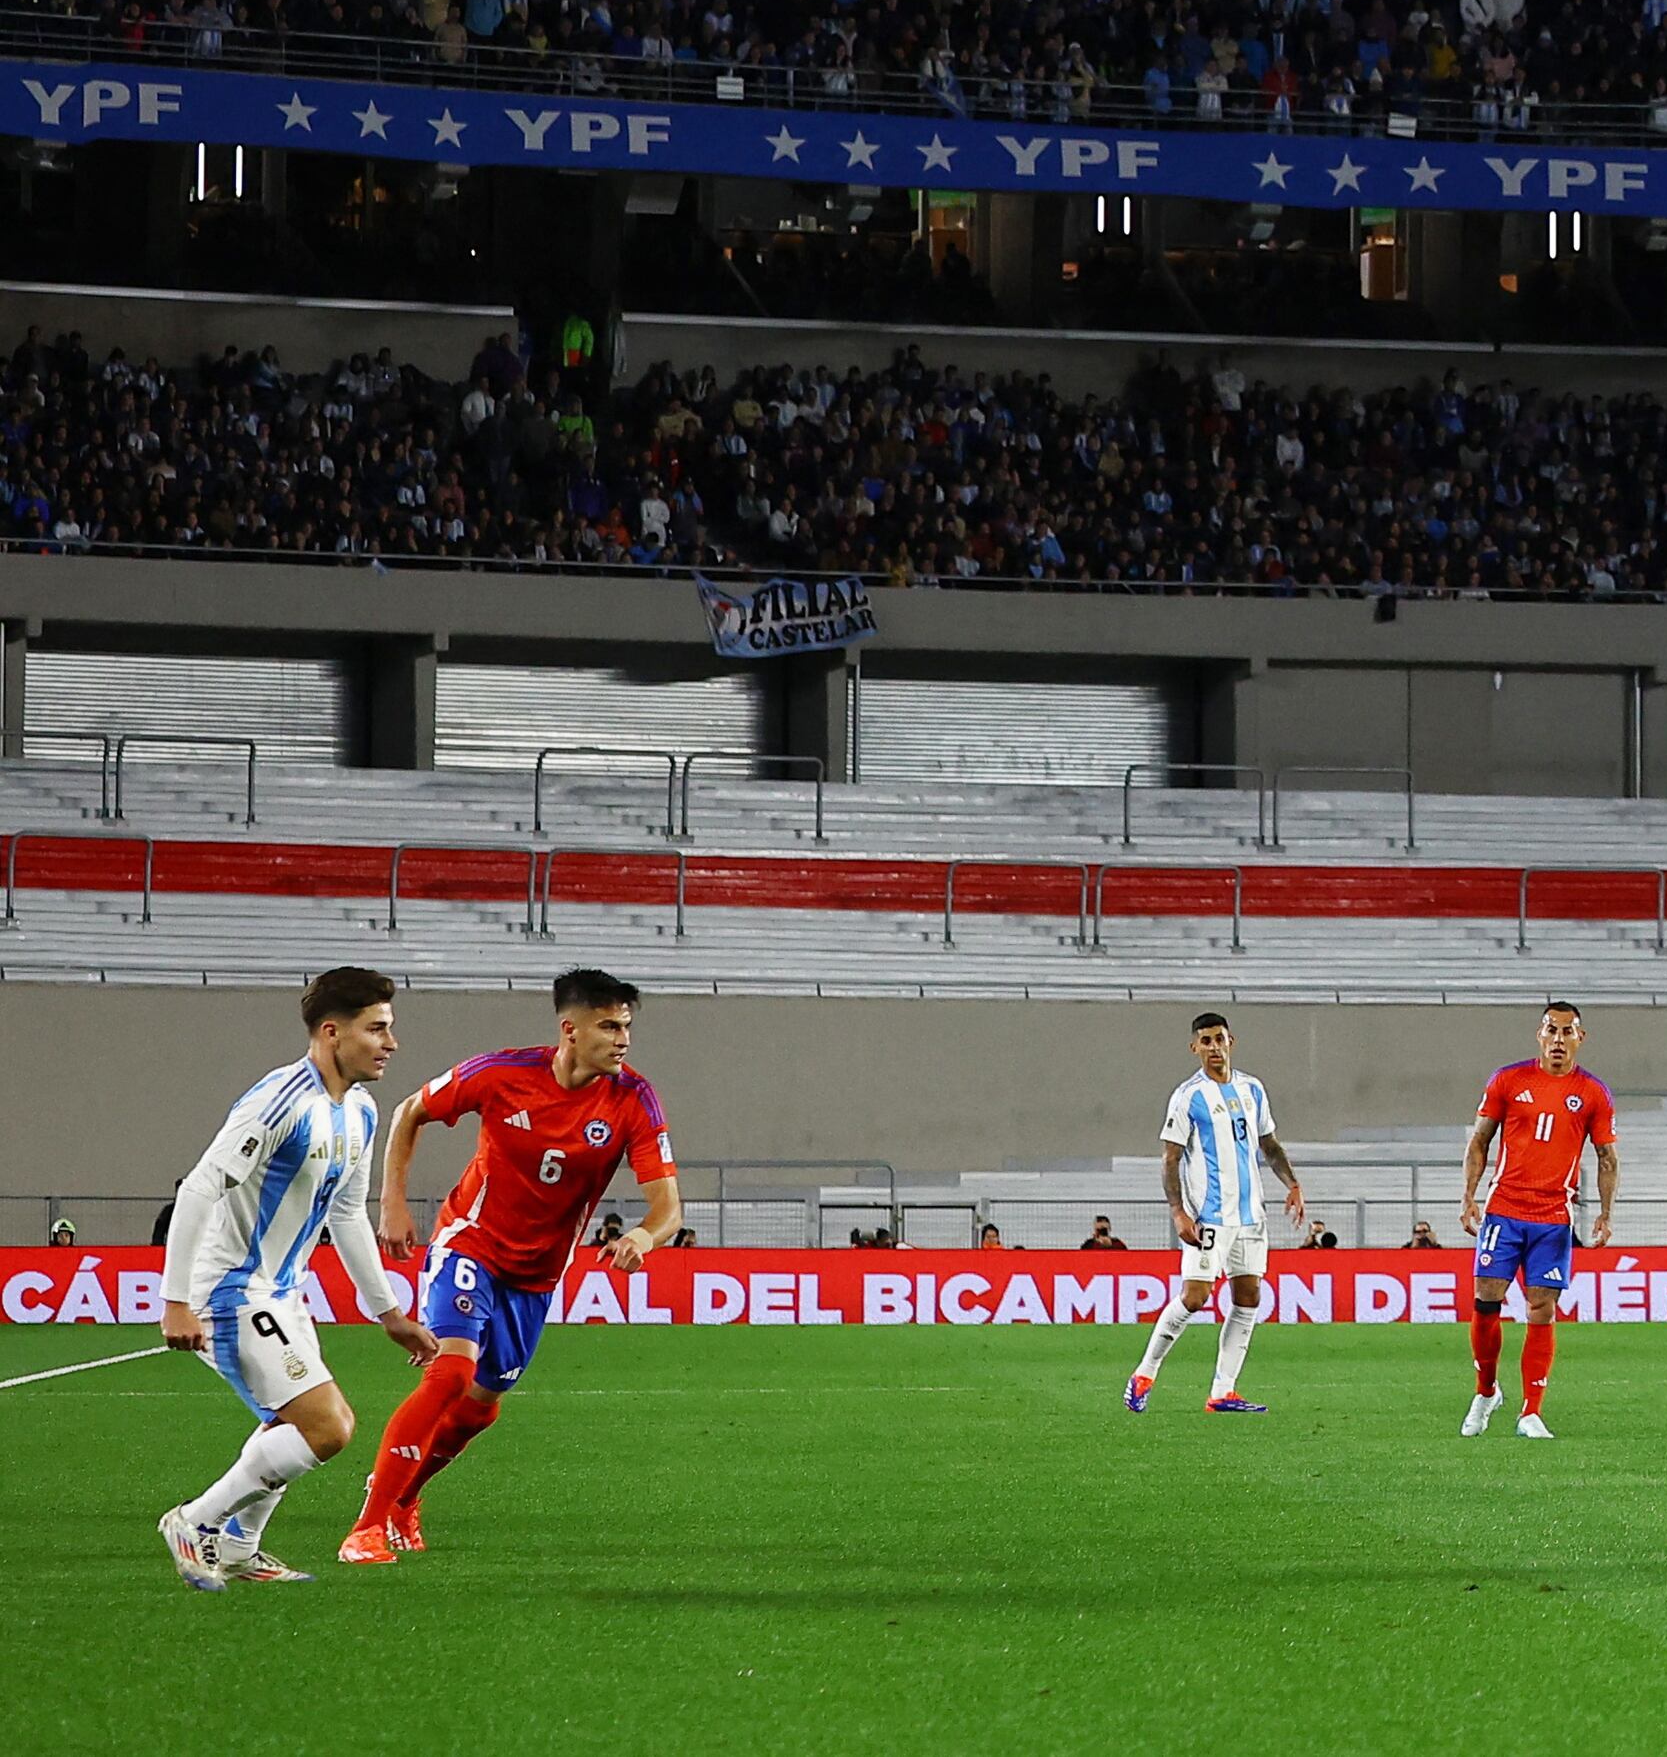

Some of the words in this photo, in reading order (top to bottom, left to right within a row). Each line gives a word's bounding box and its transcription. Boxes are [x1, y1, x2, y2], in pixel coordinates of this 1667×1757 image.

[21, 79, 183, 127] YPF
[505, 109, 672, 155] YPF
[996, 135, 1160, 180] YPF
[1483, 157, 1650, 200] YPF
[750, 580, 868, 625] FILIAL
[749, 609, 877, 650] CASTELAR
[1232, 1118, 1247, 1141] 13
[1535, 1112, 1554, 1141] 11
[539, 1149, 566, 1184] 6
[1482, 1224, 1501, 1251] 11
[2, 1255, 338, 1324] CÁBA
[692, 1271, 843, 1324] DEL
[1354, 1271, 1457, 1323] DE
[455, 1257, 478, 1291] 6
[252, 1311, 290, 1346] 9
